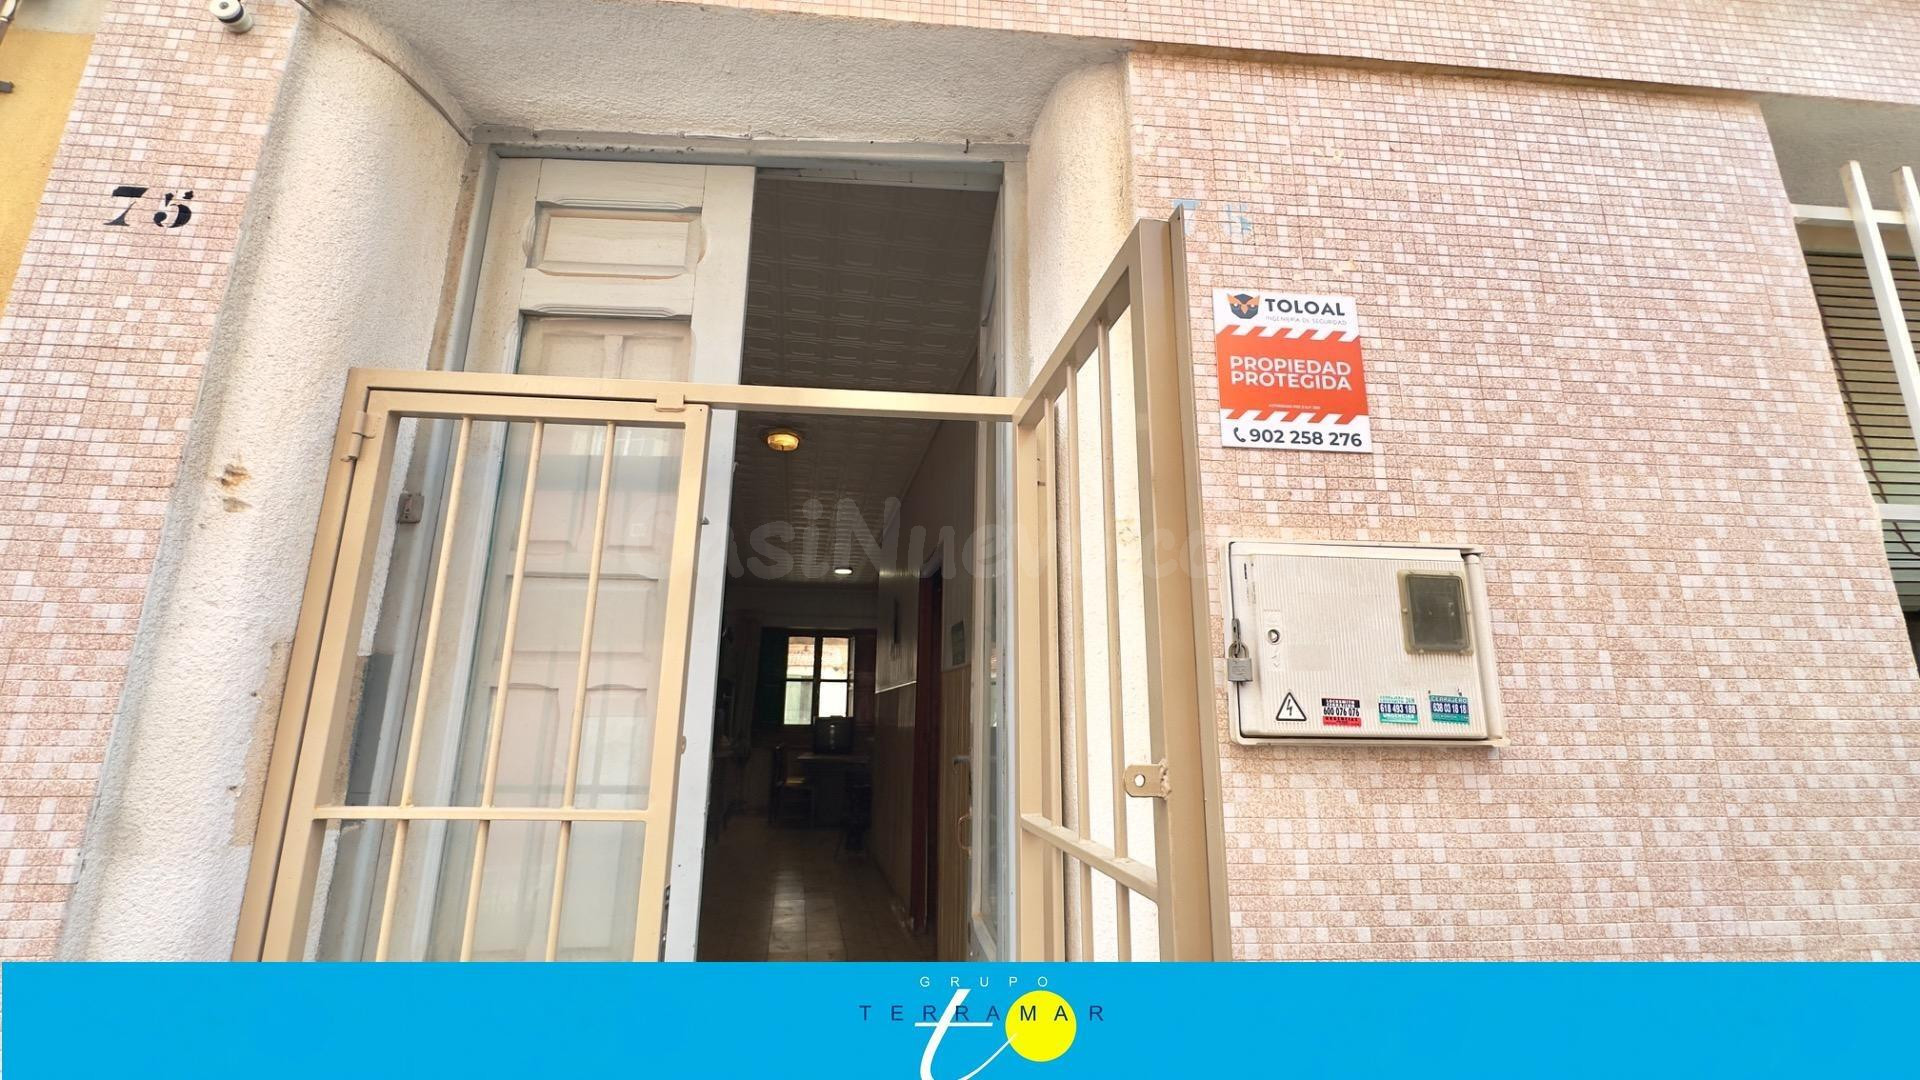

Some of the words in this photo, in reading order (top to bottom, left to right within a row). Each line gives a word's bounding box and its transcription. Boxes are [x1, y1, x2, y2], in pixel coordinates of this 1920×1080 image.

[103, 186, 194, 229] 75
[1264, 298, 1346, 316] TOLOAL
[1229, 355, 1352, 376] PROPIEDAD
[1231, 371, 1353, 391] PROTEGIDA
[1249, 428, 1285, 443] 902
[1290, 430, 1324, 445] 258
[1328, 432, 1363, 447] 276
